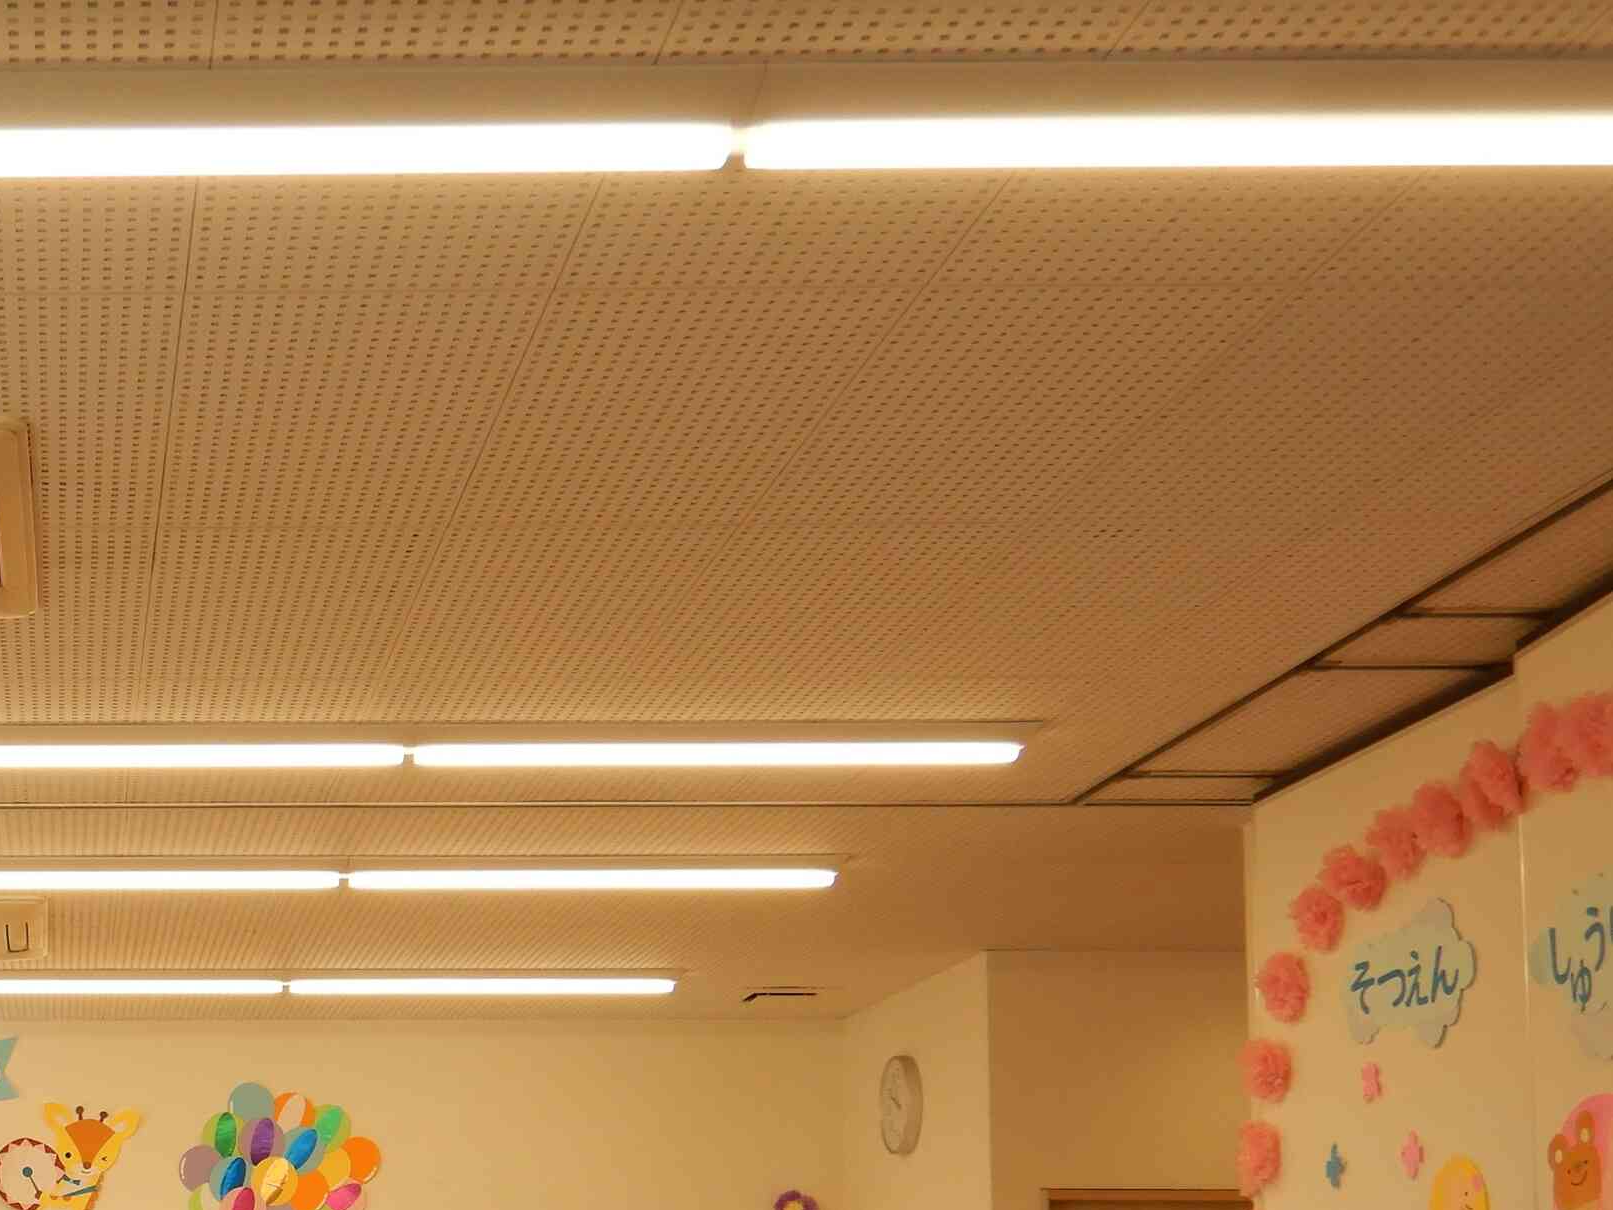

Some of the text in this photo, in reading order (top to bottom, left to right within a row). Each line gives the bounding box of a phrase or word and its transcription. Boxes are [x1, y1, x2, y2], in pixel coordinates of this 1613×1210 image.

[1350, 945, 1460, 1015] そつえん
[1547, 905, 1613, 1013] しゅう
